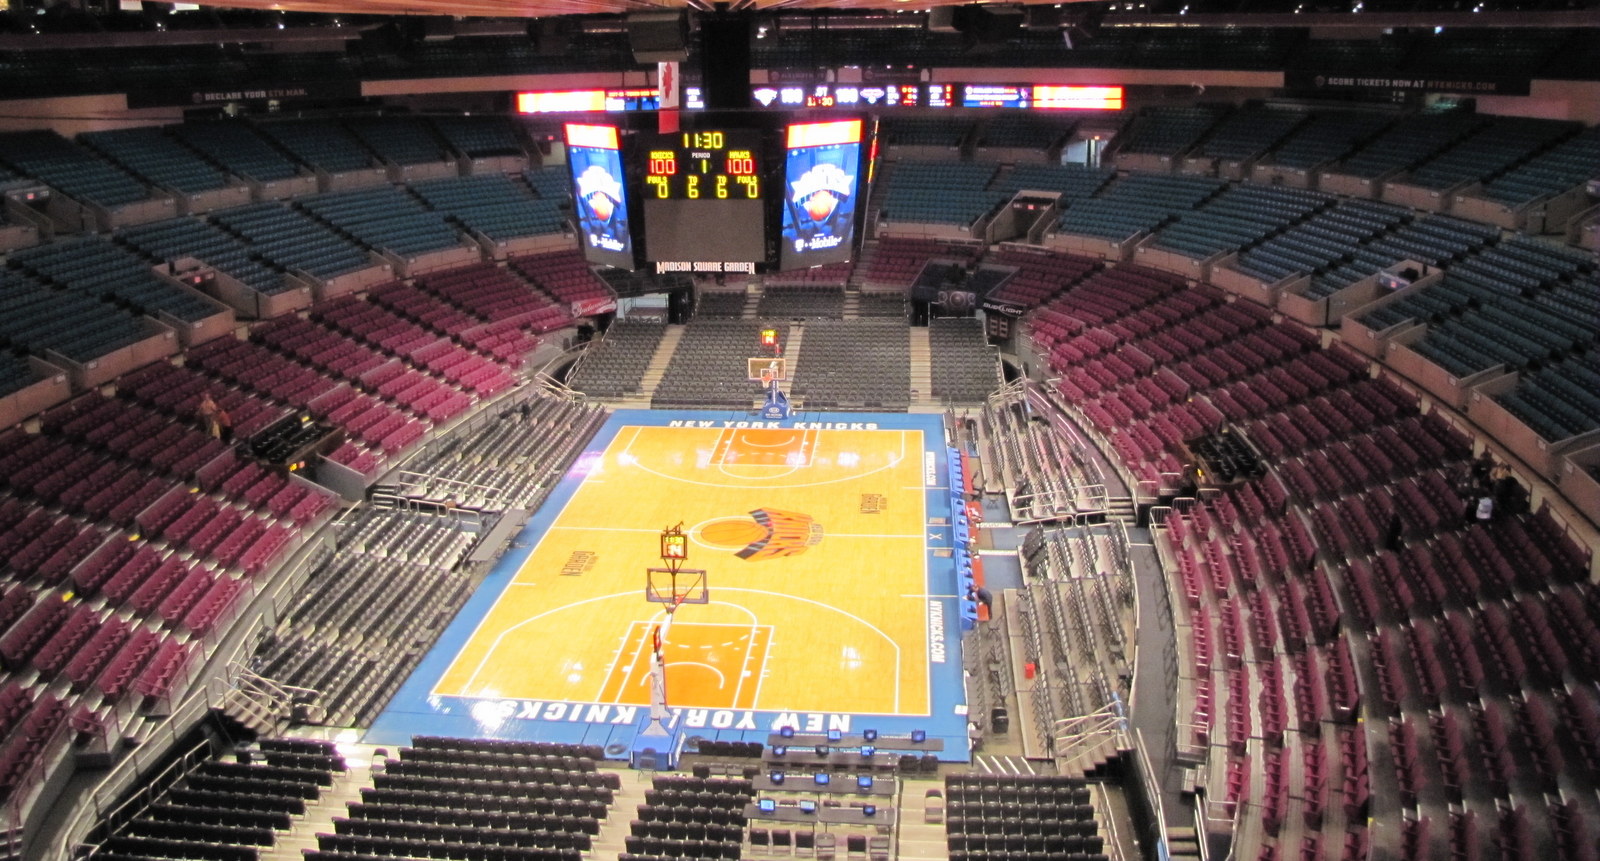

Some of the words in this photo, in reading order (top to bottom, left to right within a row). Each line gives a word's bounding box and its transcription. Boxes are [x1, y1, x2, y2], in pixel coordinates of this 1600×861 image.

[1328, 77, 1354, 86] SCORE
[1357, 78, 1390, 87] TICKETS
[1392, 79, 1411, 88] NOW
[1413, 79, 1425, 88] AT
[205, 92, 242, 101] DECLARE
[244, 91, 266, 99] YOUR
[684, 132, 723, 149] 11:30
[650, 159, 675, 174] 100
[702, 159, 707, 174] 1
[728, 159, 753, 174] 100
[646, 176, 667, 184] FOULS
[737, 176, 757, 184] FOULS
[658, 184, 668, 199] 0
[688, 184, 699, 199] 6
[717, 184, 727, 199] 6
[748, 184, 758, 199] 0
[656, 262, 691, 274] MADISON
[693, 262, 722, 272] SQUARE
[724, 262, 755, 274] GARDEN
[669, 420, 713, 428] NEW
[724, 421, 780, 429] YORK
[793, 421, 878, 430] KNICKS
[929, 600, 945, 663] NYKNICKS.COM
[501, 698, 637, 725] KNICKS
[772, 708, 850, 733] NEW
